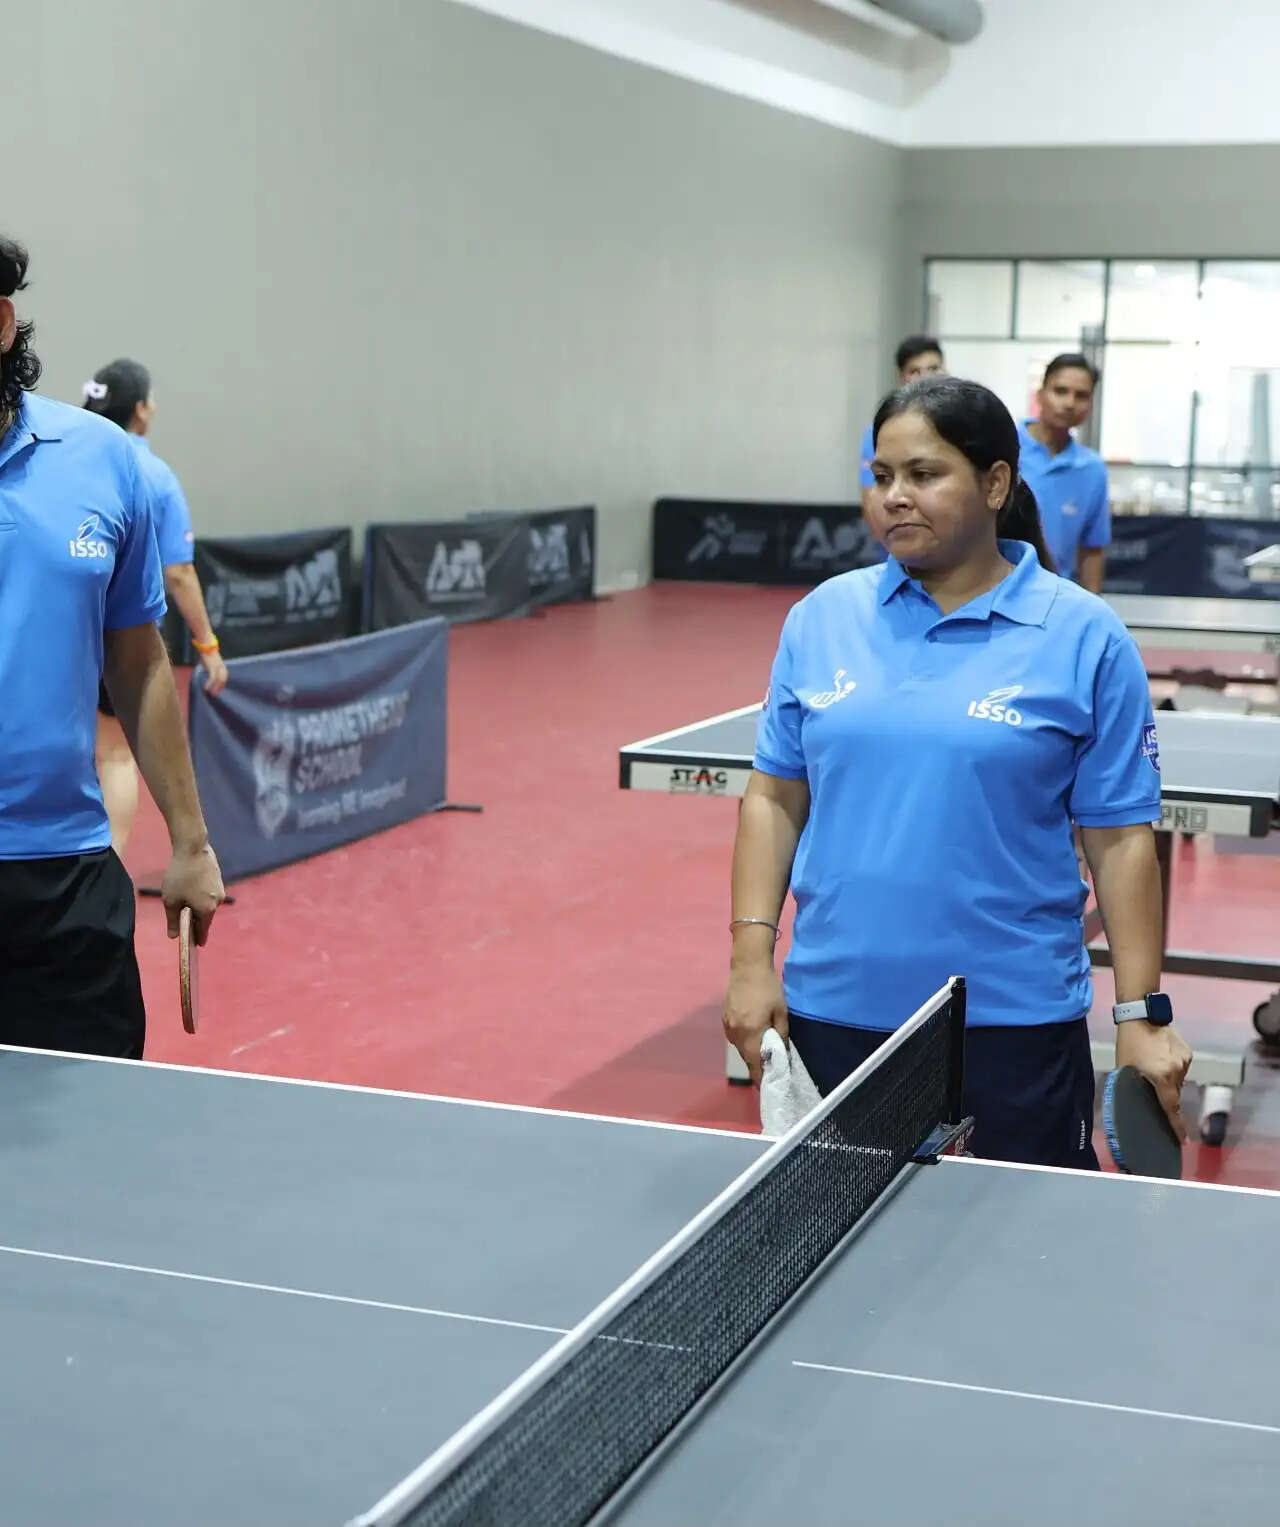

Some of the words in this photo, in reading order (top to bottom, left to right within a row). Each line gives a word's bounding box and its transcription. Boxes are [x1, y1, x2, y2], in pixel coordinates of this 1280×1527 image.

[69, 540, 107, 558] ISSO
[968, 700, 1022, 726] ISSO
[670, 768, 728, 787] STAG
[1160, 806, 1208, 832] PRO
